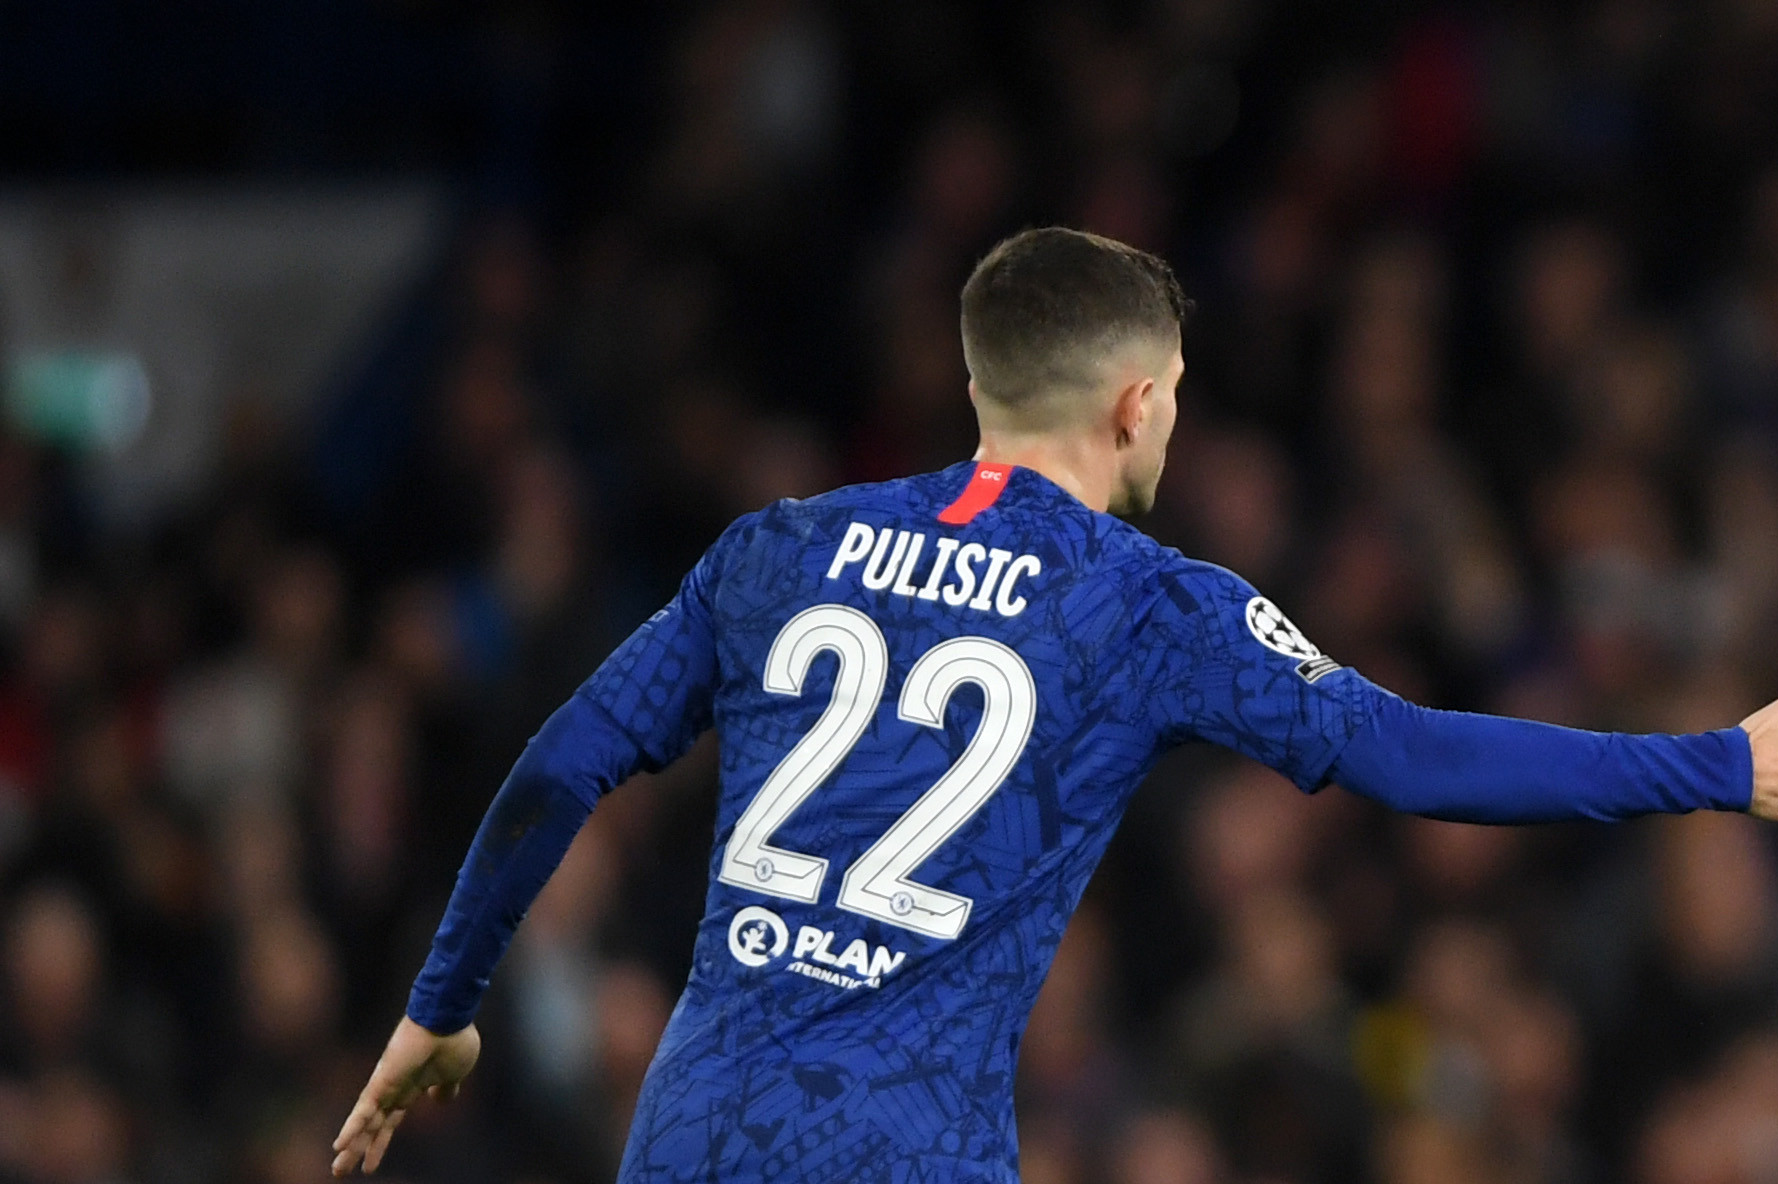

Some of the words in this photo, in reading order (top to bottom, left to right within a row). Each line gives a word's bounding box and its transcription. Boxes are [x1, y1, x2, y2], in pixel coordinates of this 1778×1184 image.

[826, 522, 1041, 616] PULISIC
[718, 604, 1036, 939] 22
[793, 925, 906, 977] PLAN
